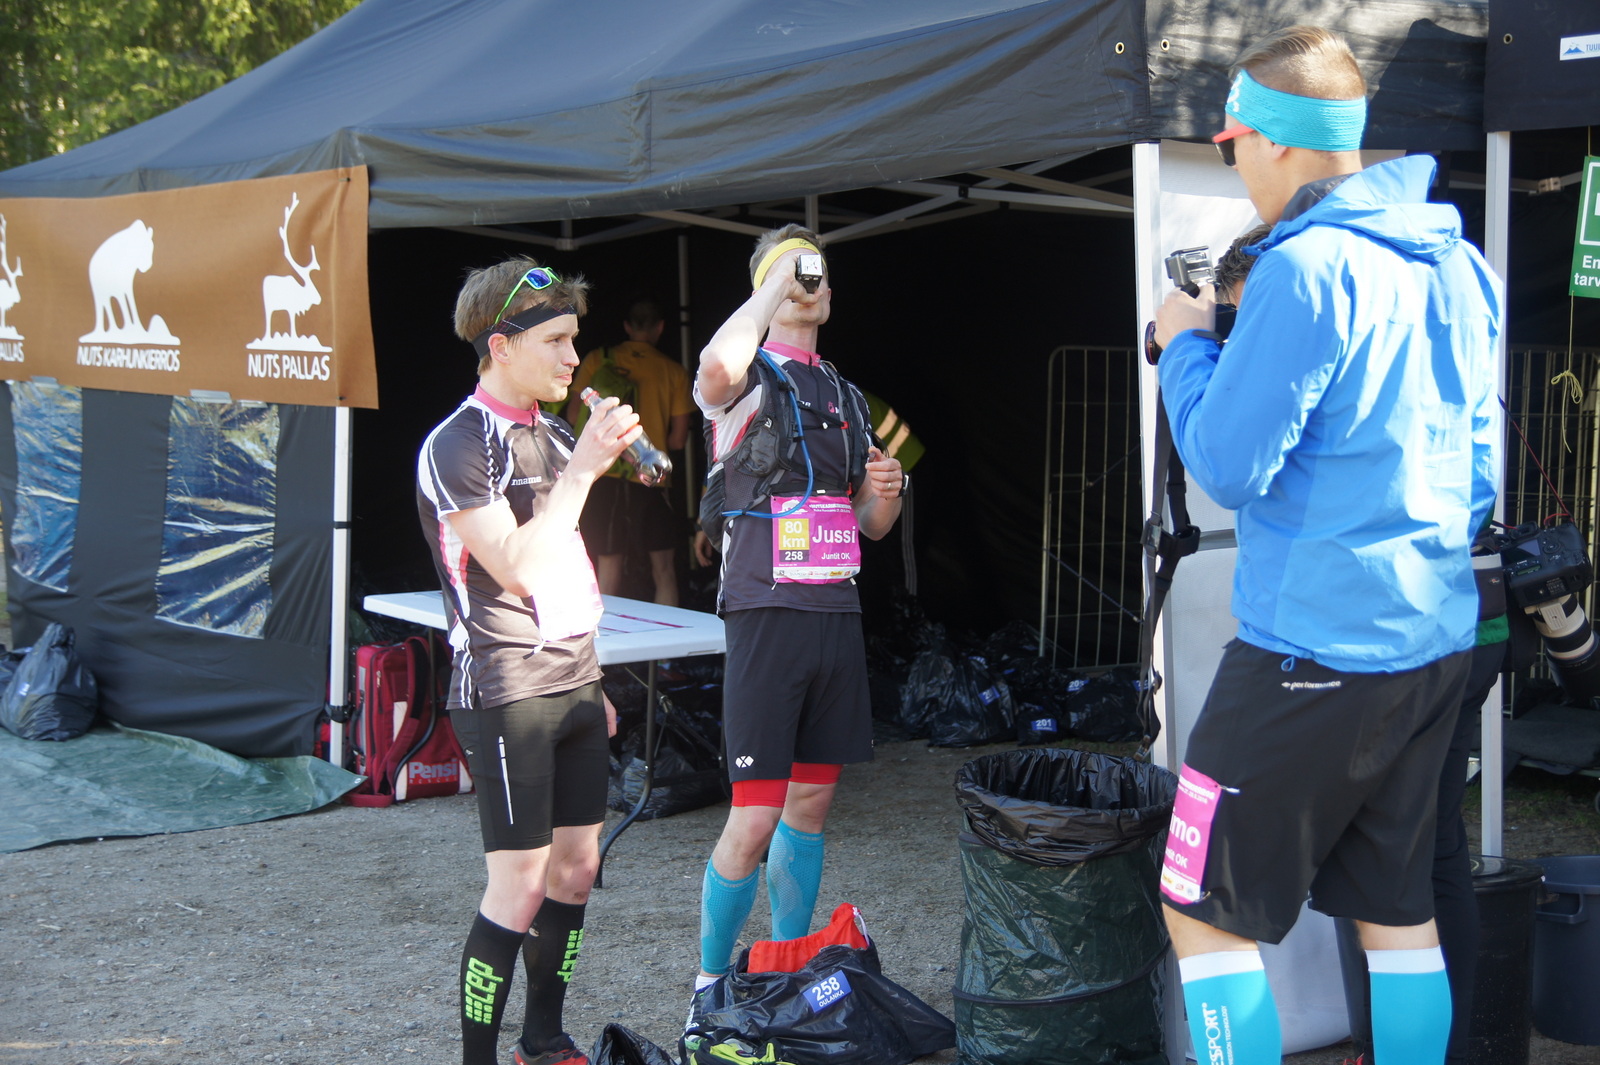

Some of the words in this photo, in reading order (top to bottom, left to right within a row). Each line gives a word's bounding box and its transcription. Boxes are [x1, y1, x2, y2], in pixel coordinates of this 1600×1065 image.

[0, 341, 25, 363] ALLAS
[76, 345, 103, 367] NUTS
[103, 347, 181, 372] KARHUNKIERROS
[247, 353, 281, 379] NUTS
[282, 354, 331, 381] PALLAS
[785, 521, 803, 534] 80
[812, 525, 856, 543] Jussi
[782, 535, 806, 547] km
[784, 551, 803, 561] 258
[840, 552, 851, 560] OK
[1035, 719, 1052, 727] 201
[408, 758, 457, 779] Pensi
[1175, 853, 1188, 869] OK
[811, 976, 841, 1001] 258
[818, 989, 845, 1007] OULANKA
